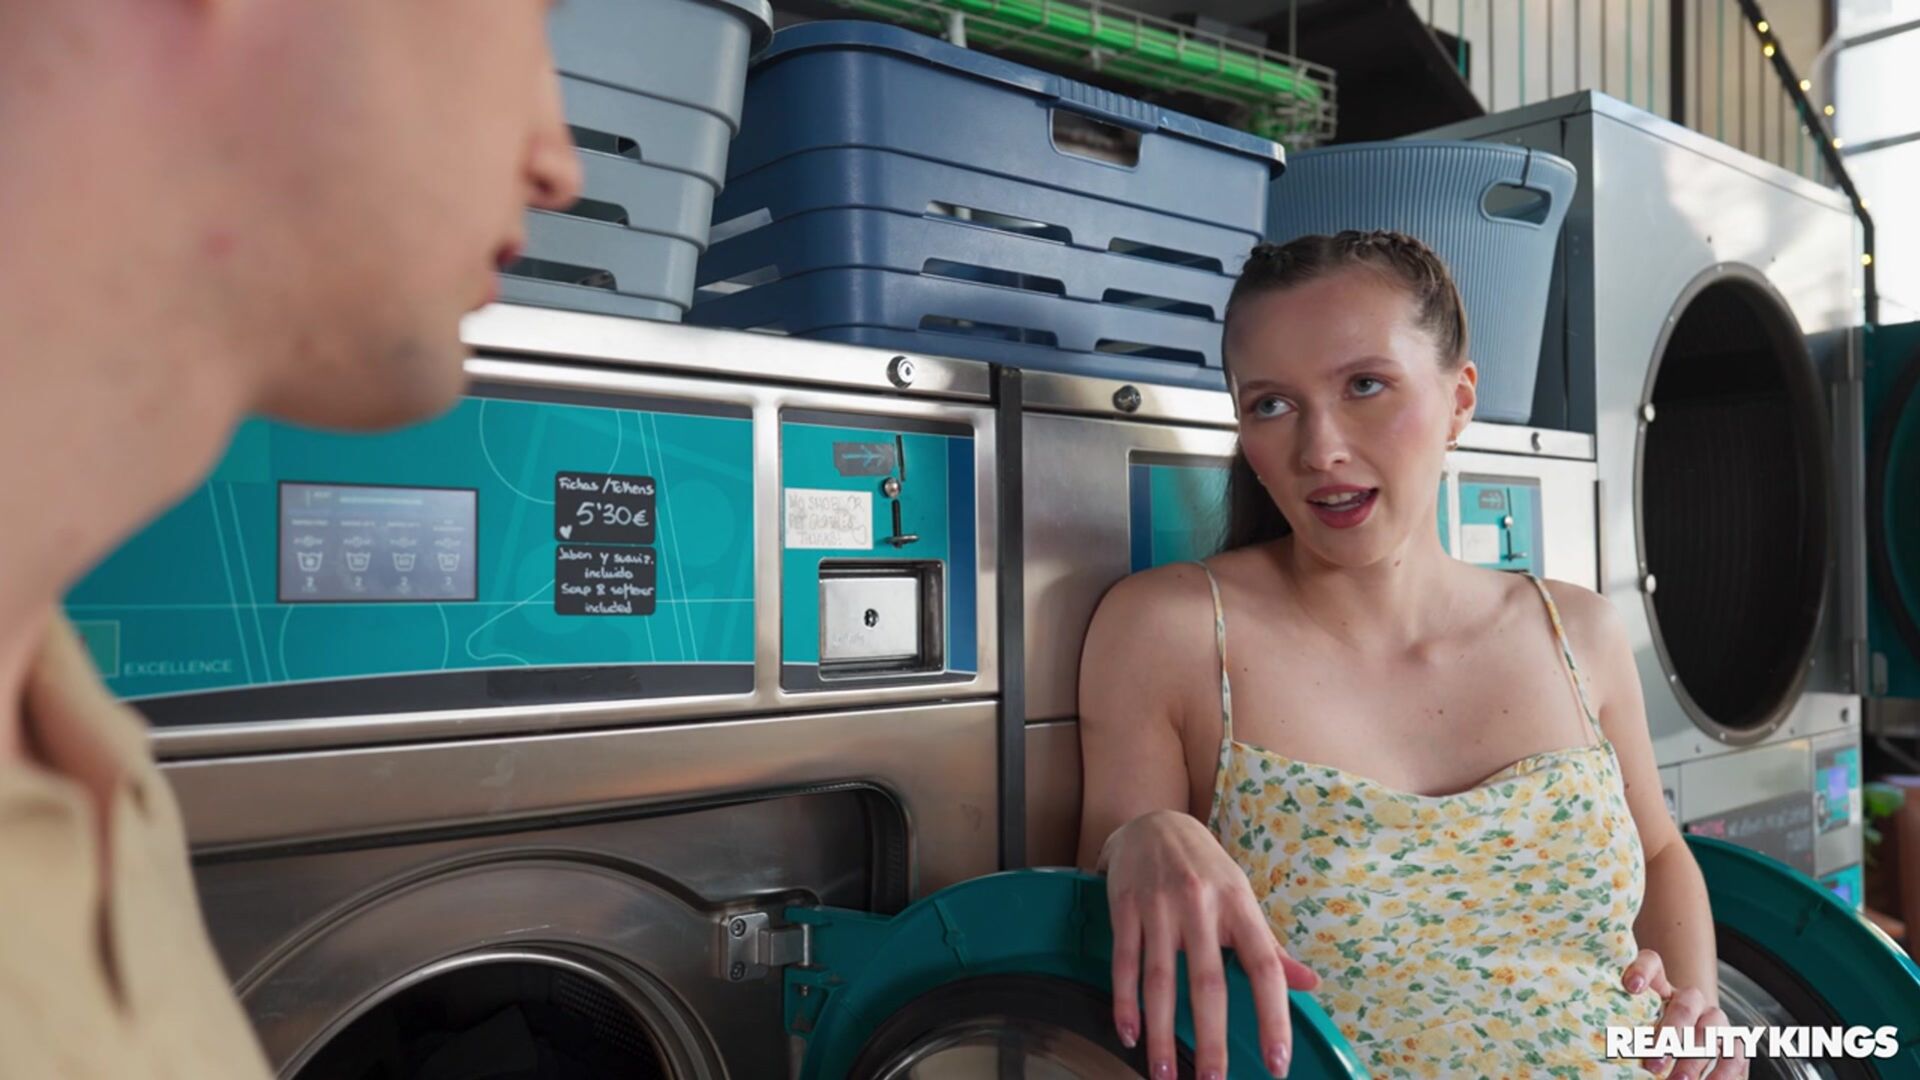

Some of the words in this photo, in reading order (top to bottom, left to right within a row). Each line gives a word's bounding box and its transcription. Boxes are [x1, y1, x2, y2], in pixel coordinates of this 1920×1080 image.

[558, 477, 599, 491] Fichas
[576, 501, 649, 527] 5'30€
[584, 566, 634, 579] incluido
[584, 600, 632, 613] included
[124, 660, 232, 676] EXCELLENCE
